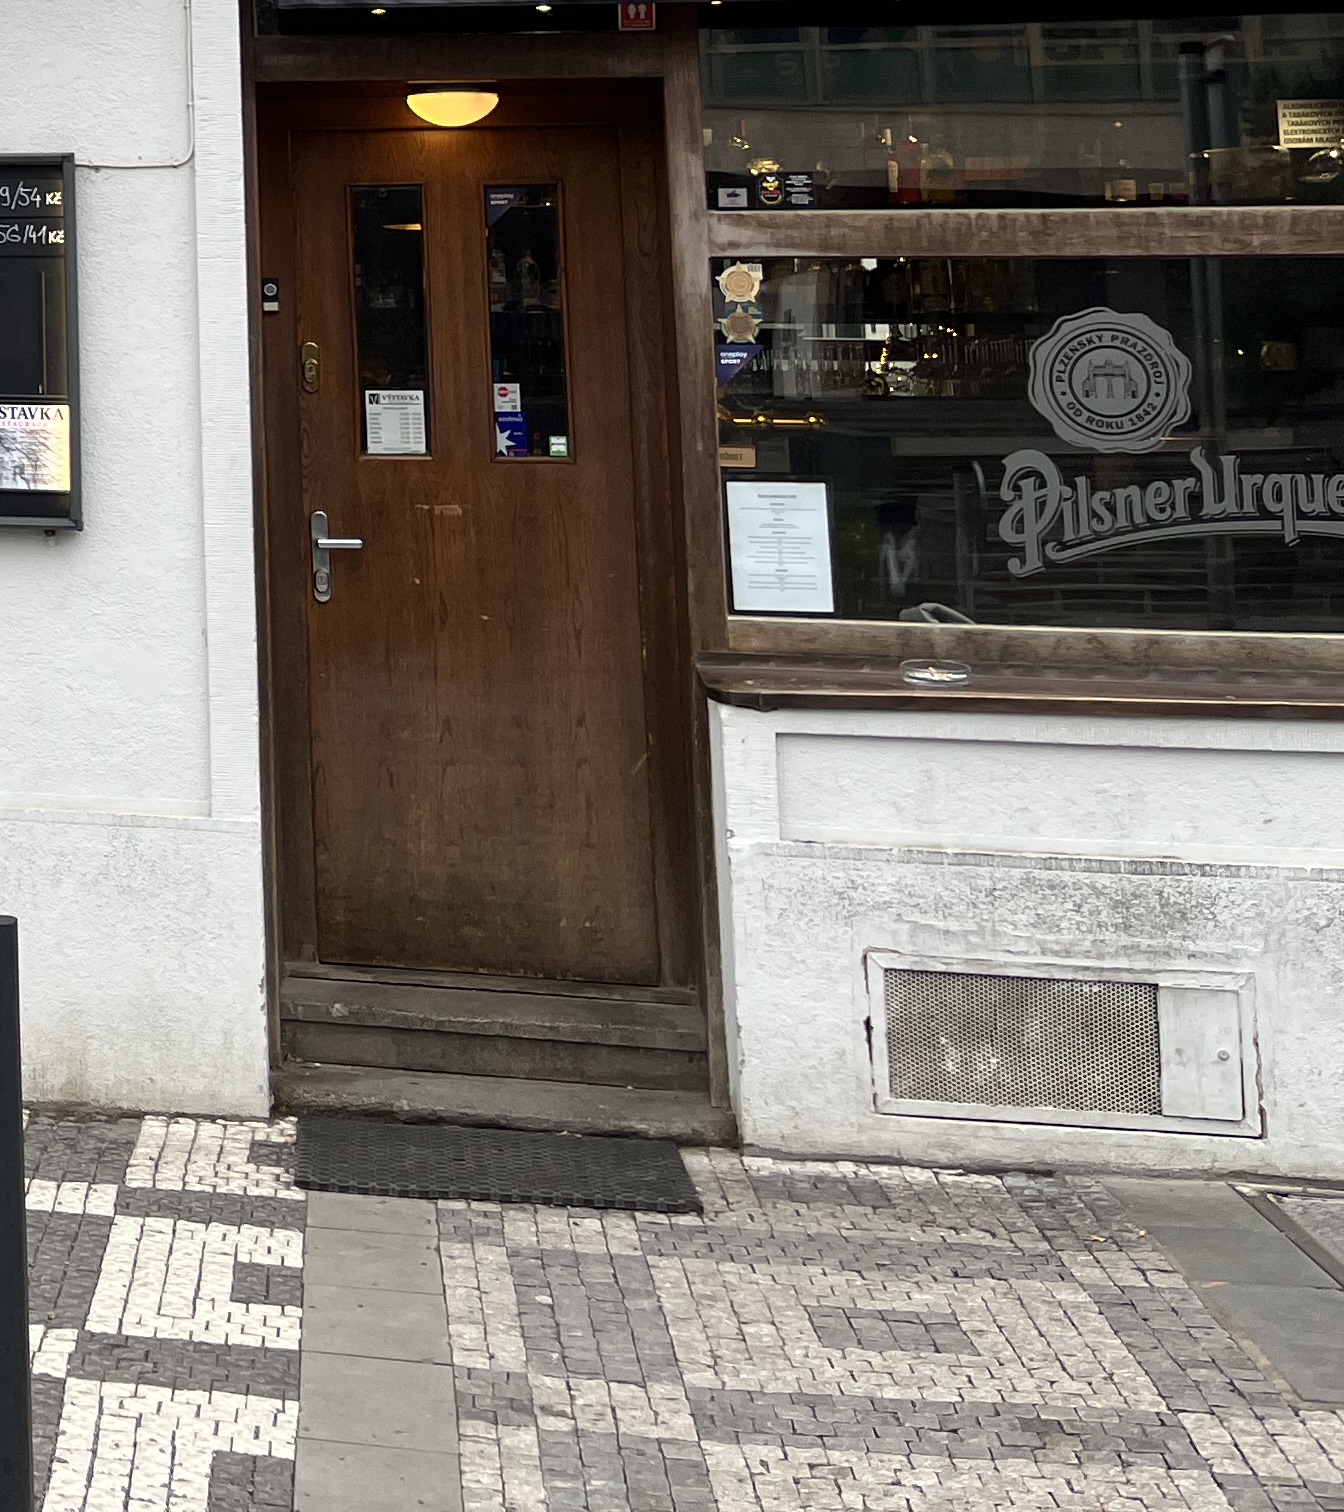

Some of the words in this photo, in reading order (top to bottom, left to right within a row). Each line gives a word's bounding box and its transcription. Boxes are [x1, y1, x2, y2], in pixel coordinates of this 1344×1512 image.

[45, 191, 62, 206] Kč
[48, 229, 64, 244] Kč
[1110, 334, 1165, 385] PRAZDROJ
[1085, 414, 1125, 430] ROKU
[1128, 402, 1157, 427] 1842
[999, 449, 1200, 578] Pilsner
